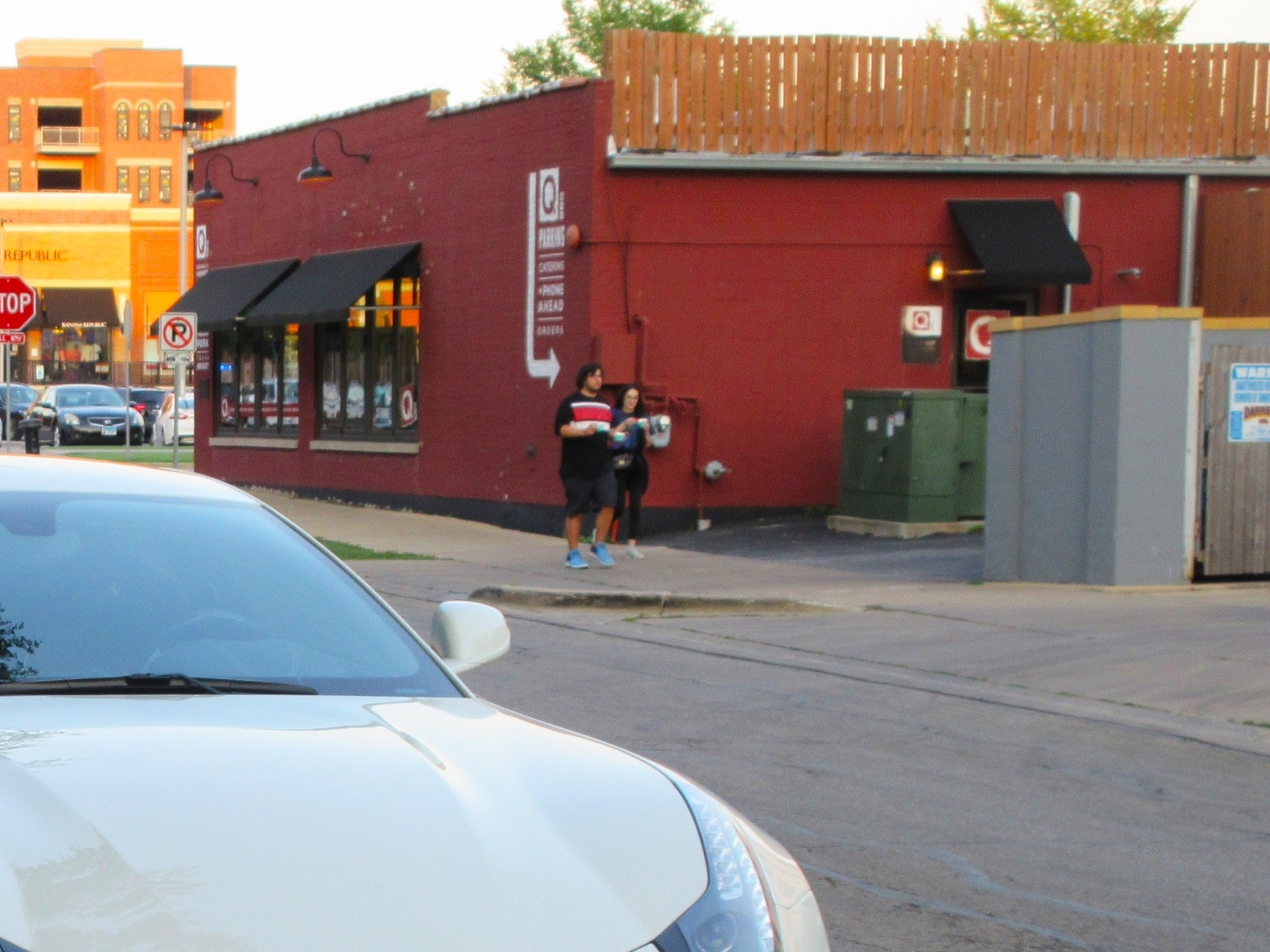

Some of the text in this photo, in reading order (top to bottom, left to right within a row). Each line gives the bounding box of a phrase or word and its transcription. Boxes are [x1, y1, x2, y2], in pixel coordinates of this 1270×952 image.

[539, 225, 566, 250] PARKING
[3, 249, 69, 261] REPUBLIC
[537, 299, 565, 313] AHEAD
